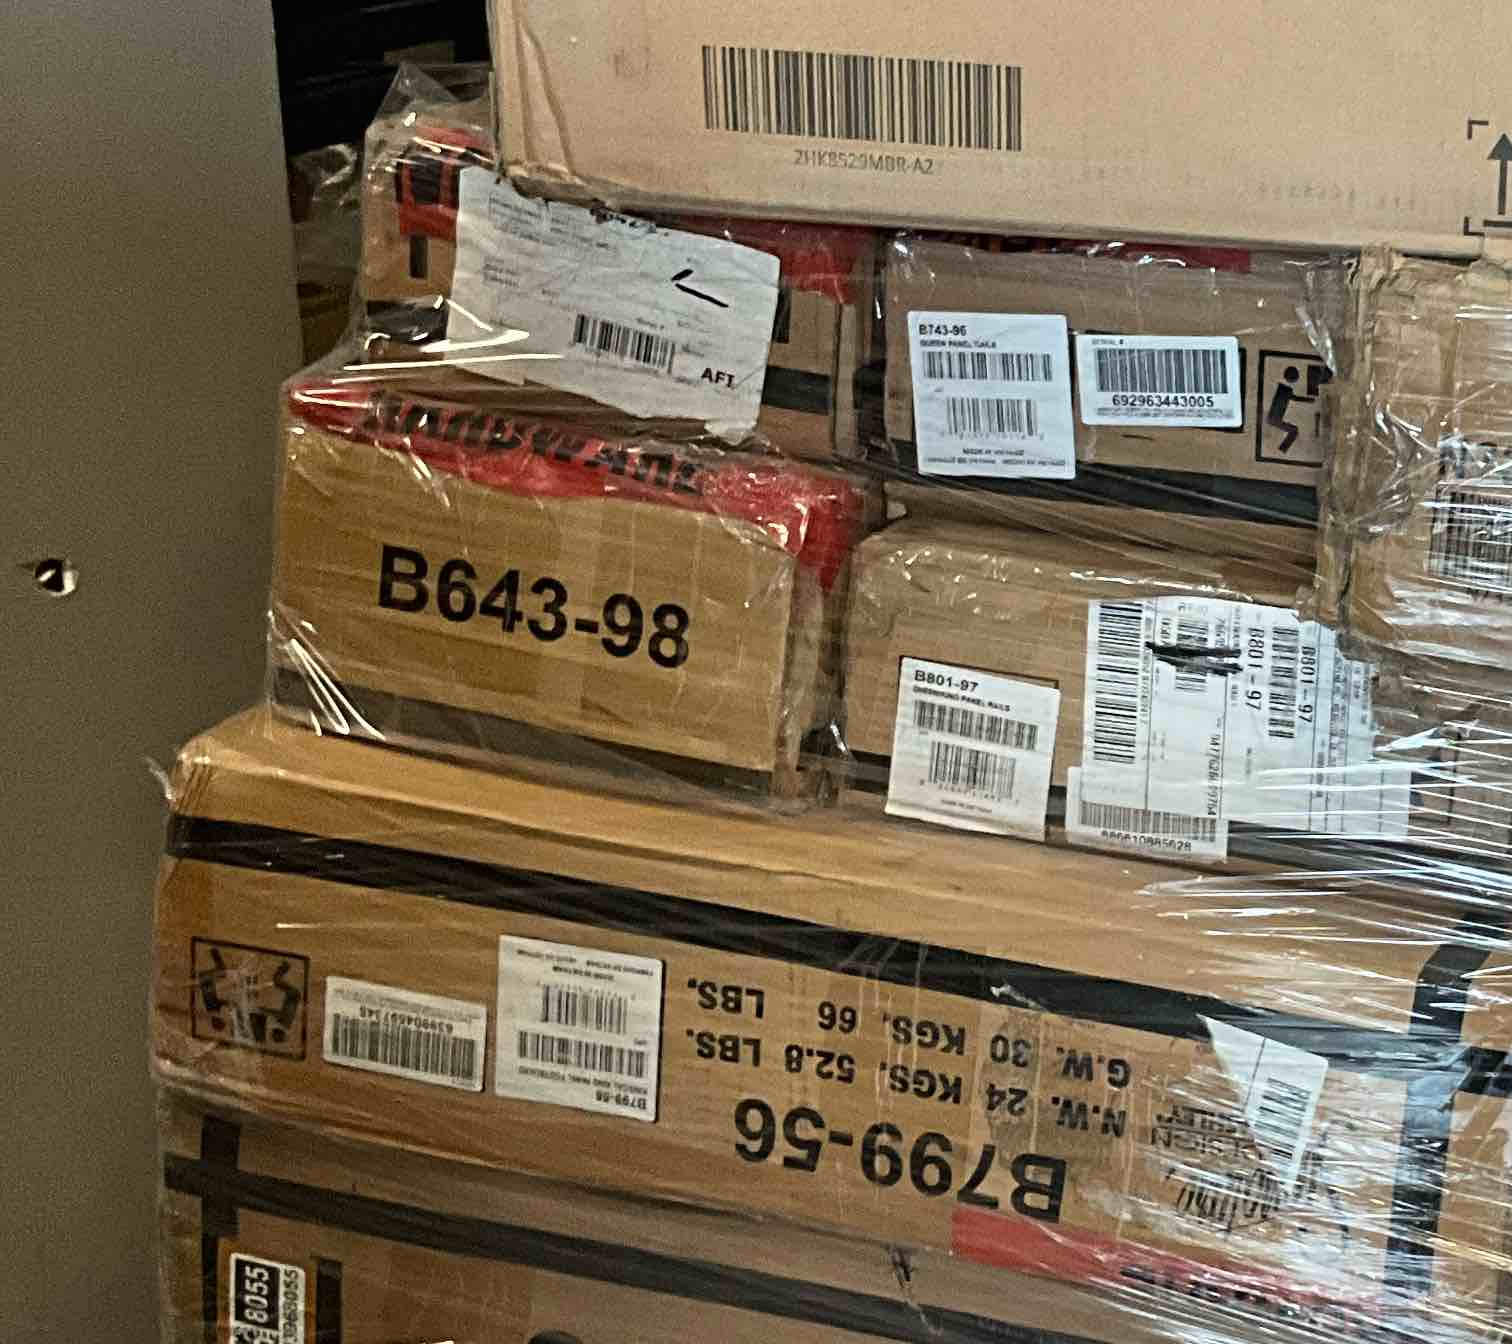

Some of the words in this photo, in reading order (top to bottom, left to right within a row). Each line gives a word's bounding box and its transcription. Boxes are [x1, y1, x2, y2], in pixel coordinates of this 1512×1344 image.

[1112, 394, 1216, 409] 692963443005
[377, 542, 691, 670] B643-98
[914, 669, 979, 693] B801-97
[688, 978, 765, 1020] LBS.
[818, 1001, 857, 1034] 66
[686, 1029, 762, 1068] LBS.
[882, 1014, 966, 1057] KGS.
[990, 1035, 1032, 1069] 30
[785, 1044, 856, 1084] 52.8
[880, 1062, 963, 1106] KGS.
[1056, 1046, 1132, 1089] G.W.
[985, 1083, 1029, 1117] 24
[1052, 1097, 1127, 1139] N.W.
[735, 1098, 1068, 1224] B799-56
[243, 1265, 270, 1324] 8055
